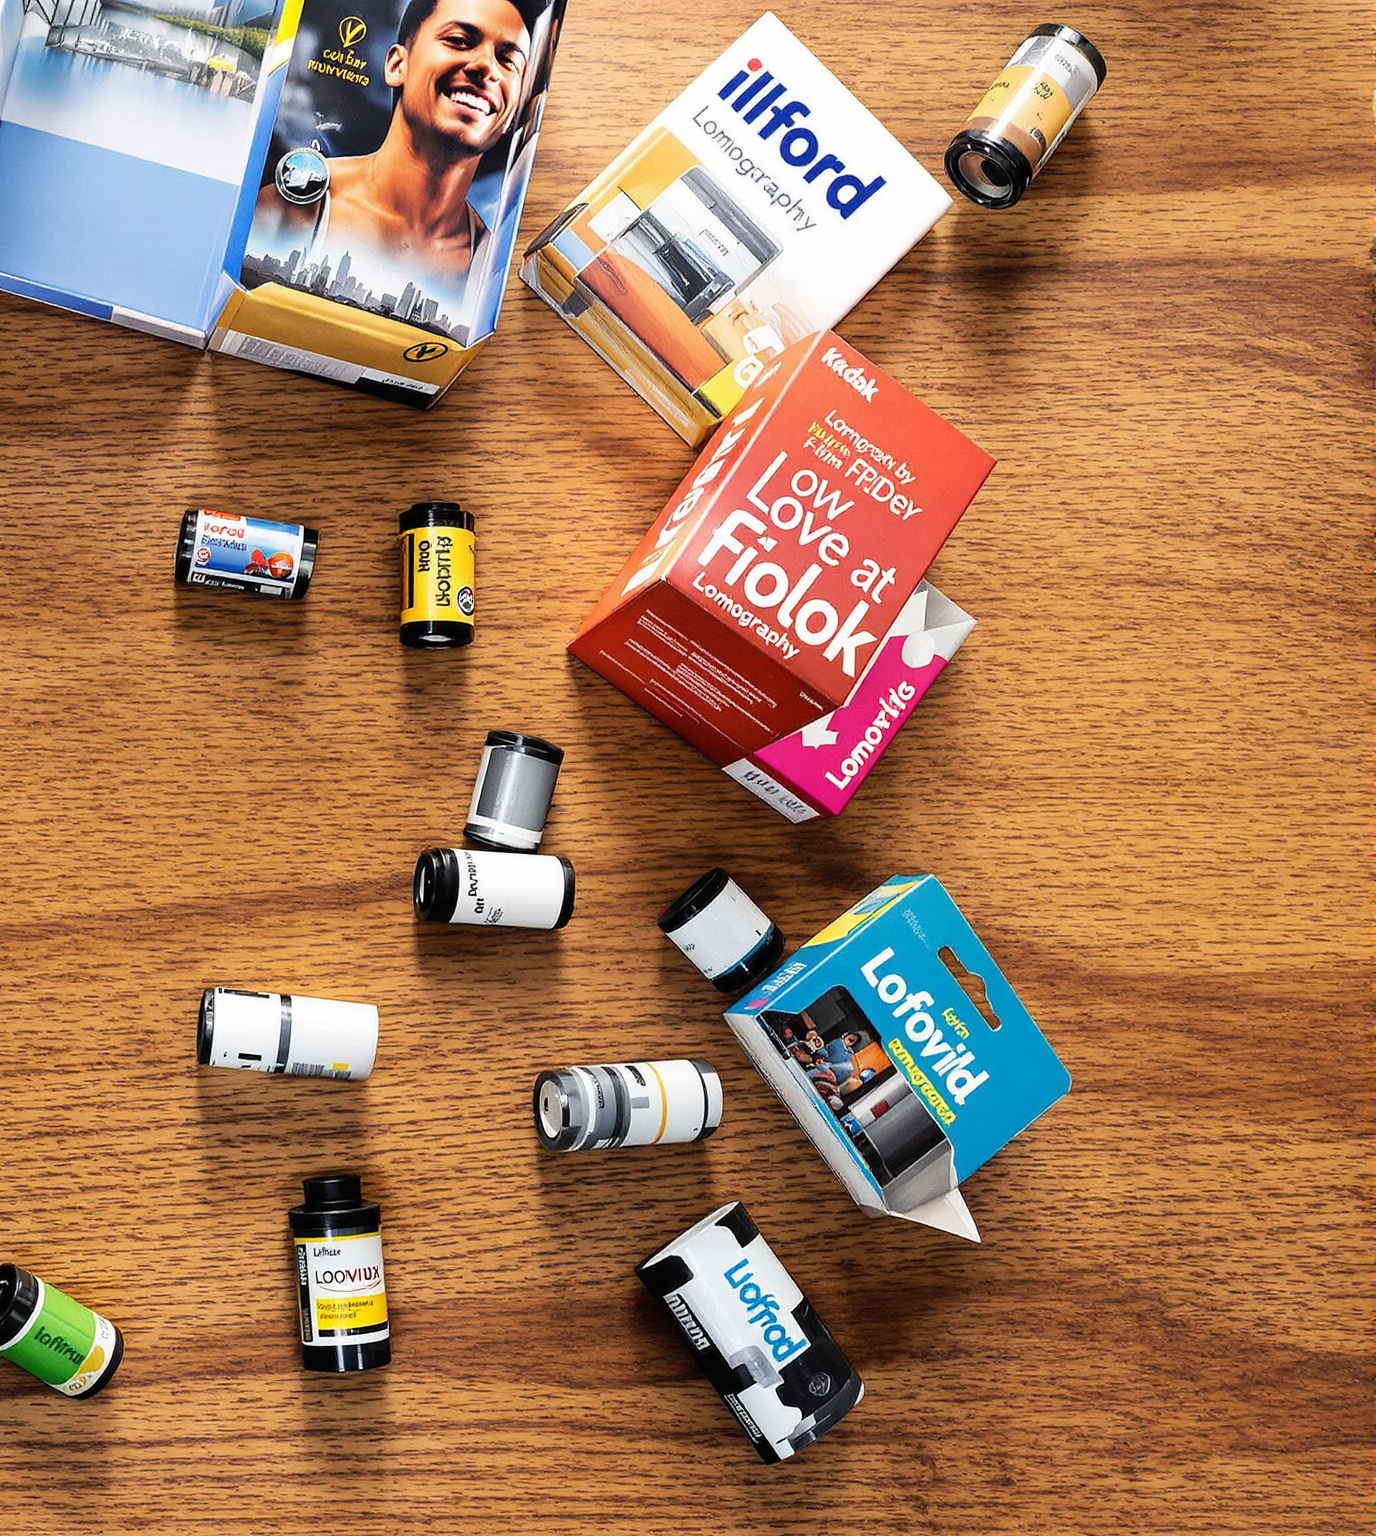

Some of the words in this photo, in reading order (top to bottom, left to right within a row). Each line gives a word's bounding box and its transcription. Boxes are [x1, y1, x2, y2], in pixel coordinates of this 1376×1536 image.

[717, 57, 887, 219] illford
[692, 571, 801, 660] Lomography
[850, 558, 897, 605] at
